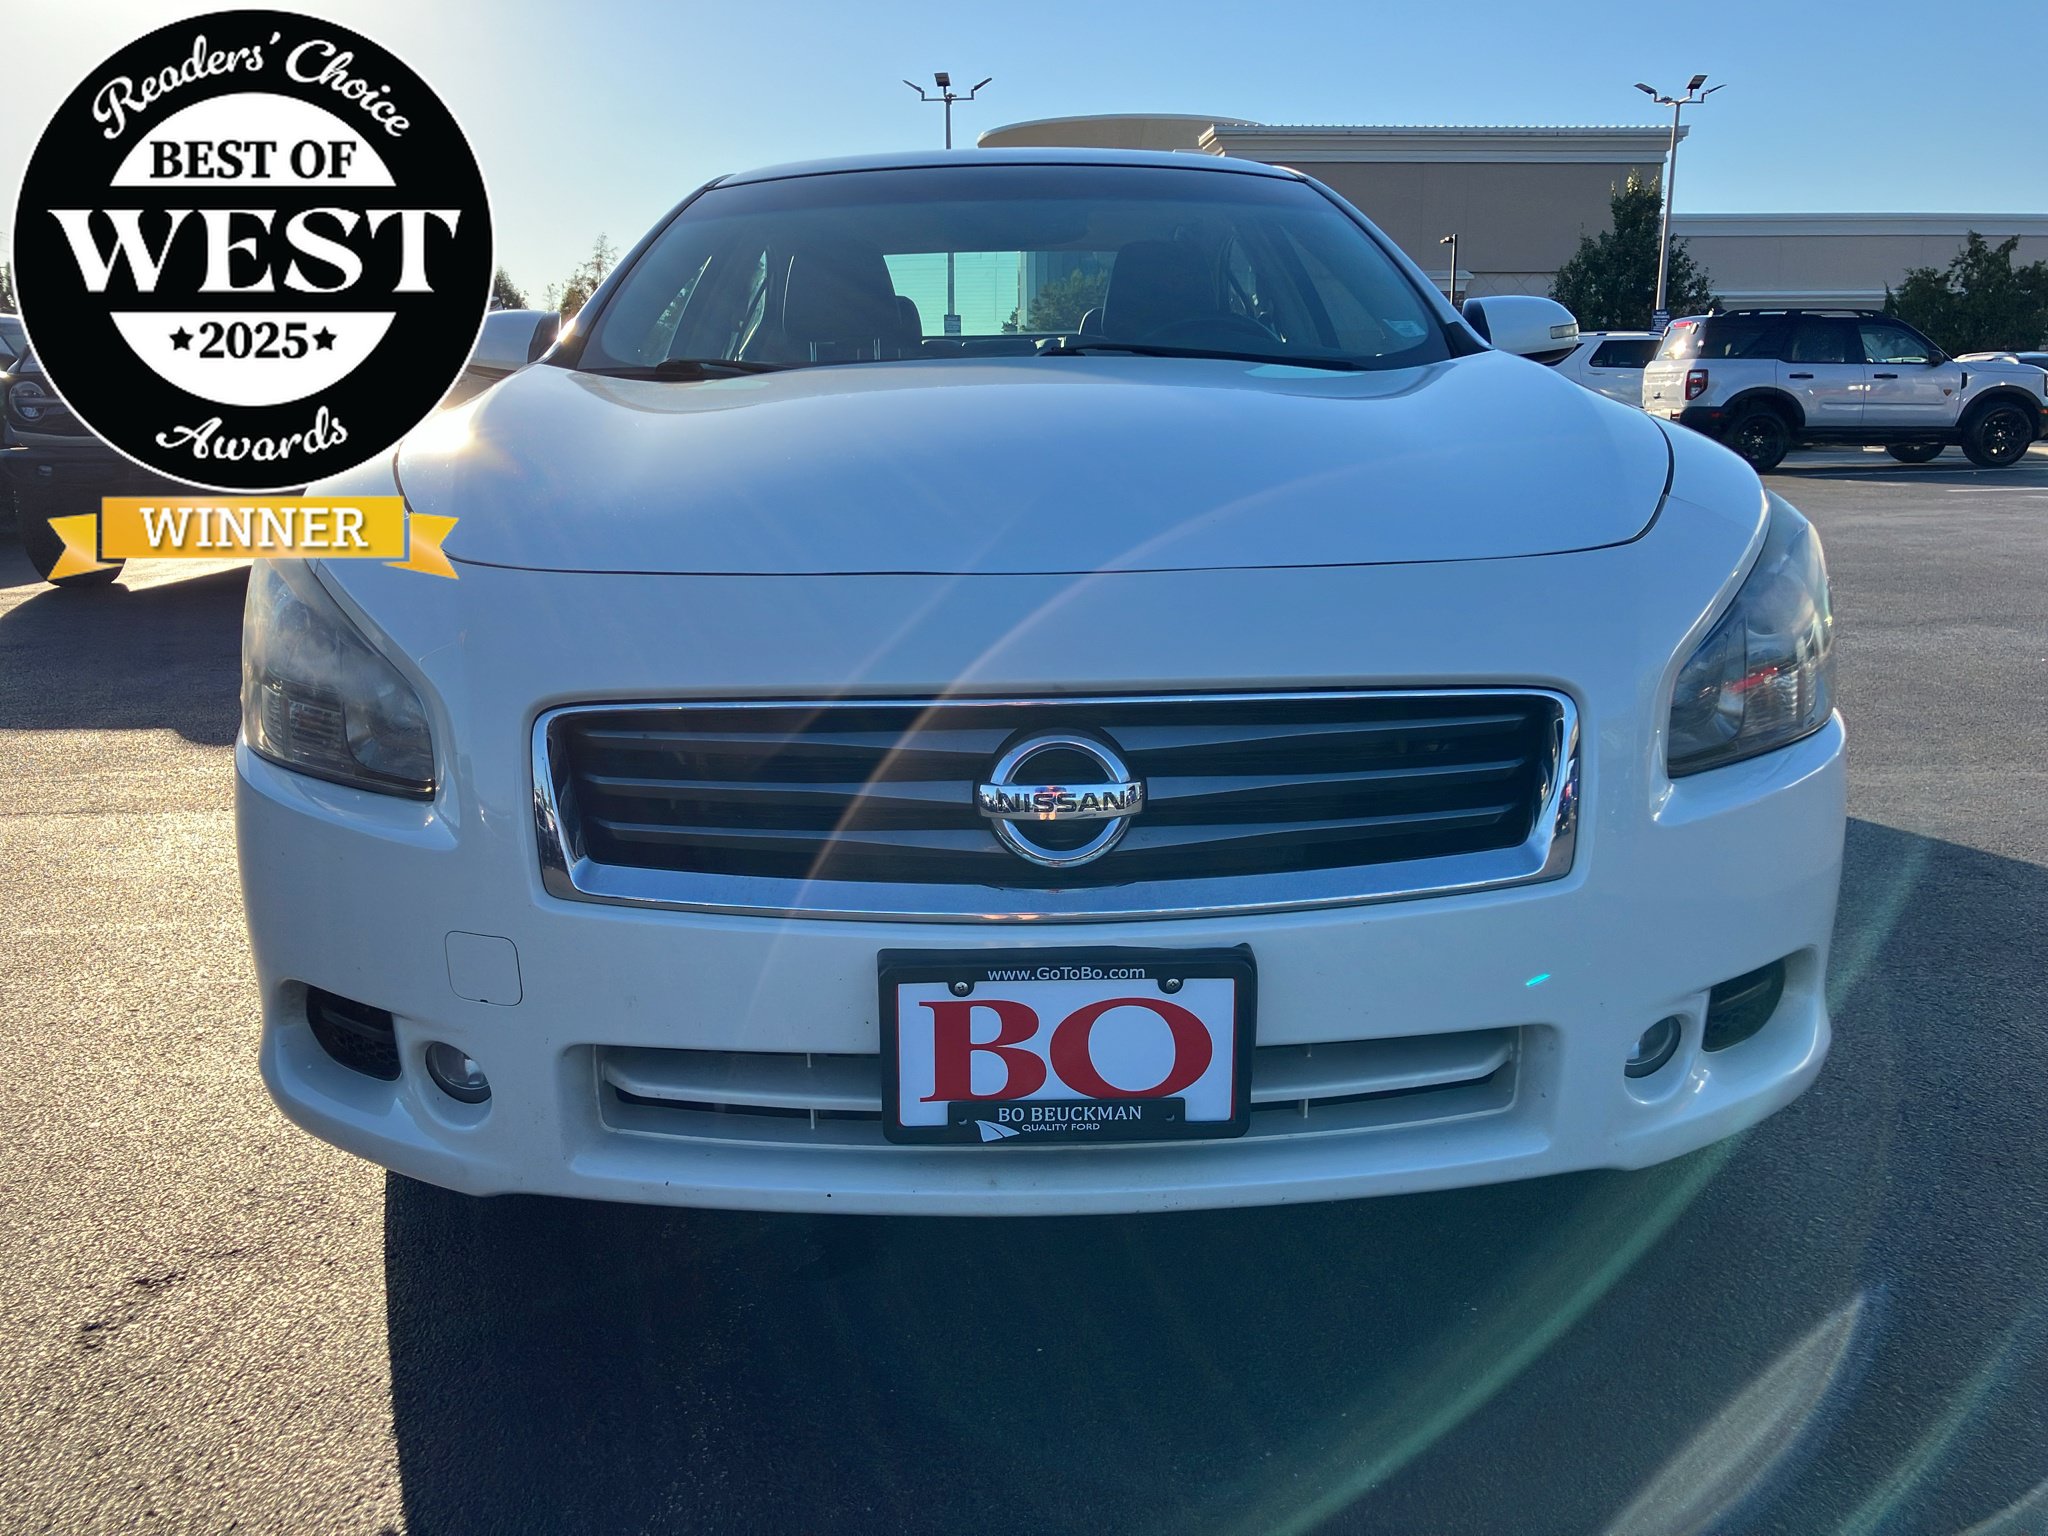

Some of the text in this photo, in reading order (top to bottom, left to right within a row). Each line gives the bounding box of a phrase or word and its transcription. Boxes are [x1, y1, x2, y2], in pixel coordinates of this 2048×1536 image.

[997, 791, 1125, 813] NISSAN
[987, 967, 1145, 981] www.GoToBo.com
[918, 997, 1213, 1103] BO
[998, 1106, 1142, 1122] BO BEUCKMAN
[1022, 1123, 1100, 1132] QUALITY FORD
